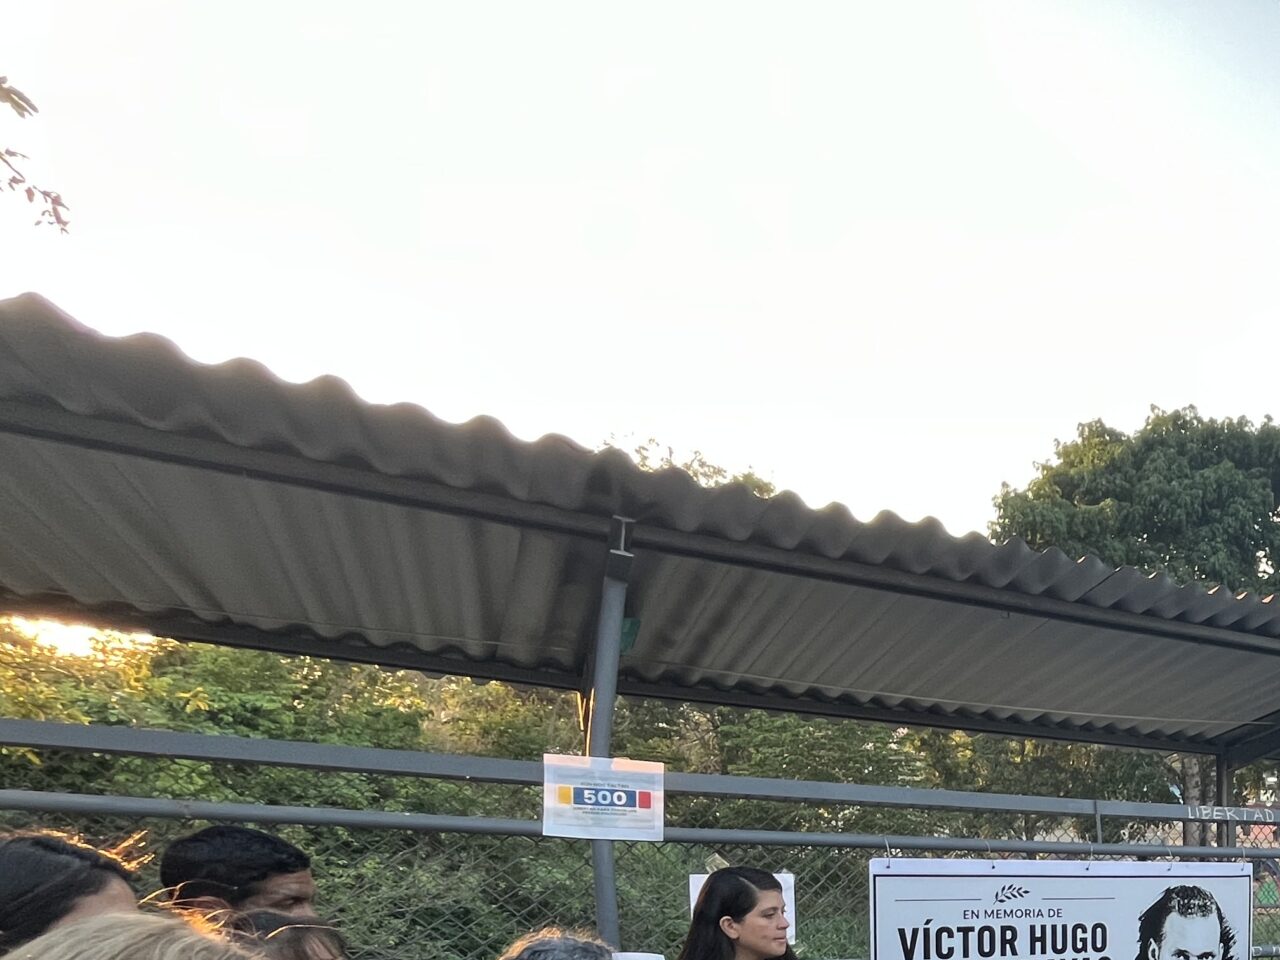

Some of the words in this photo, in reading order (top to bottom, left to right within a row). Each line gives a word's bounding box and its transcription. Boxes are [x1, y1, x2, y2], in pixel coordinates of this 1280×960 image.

[583, 789, 627, 806] 500
[1187, 805, 1275, 823] LIBERTAD
[963, 909, 980, 920] EN
[984, 908, 1044, 919] MEMORIA
[1048, 908, 1063, 918] DE
[897, 918, 1018, 960] VÍCTOR
[1029, 922, 1108, 956] HUGO
